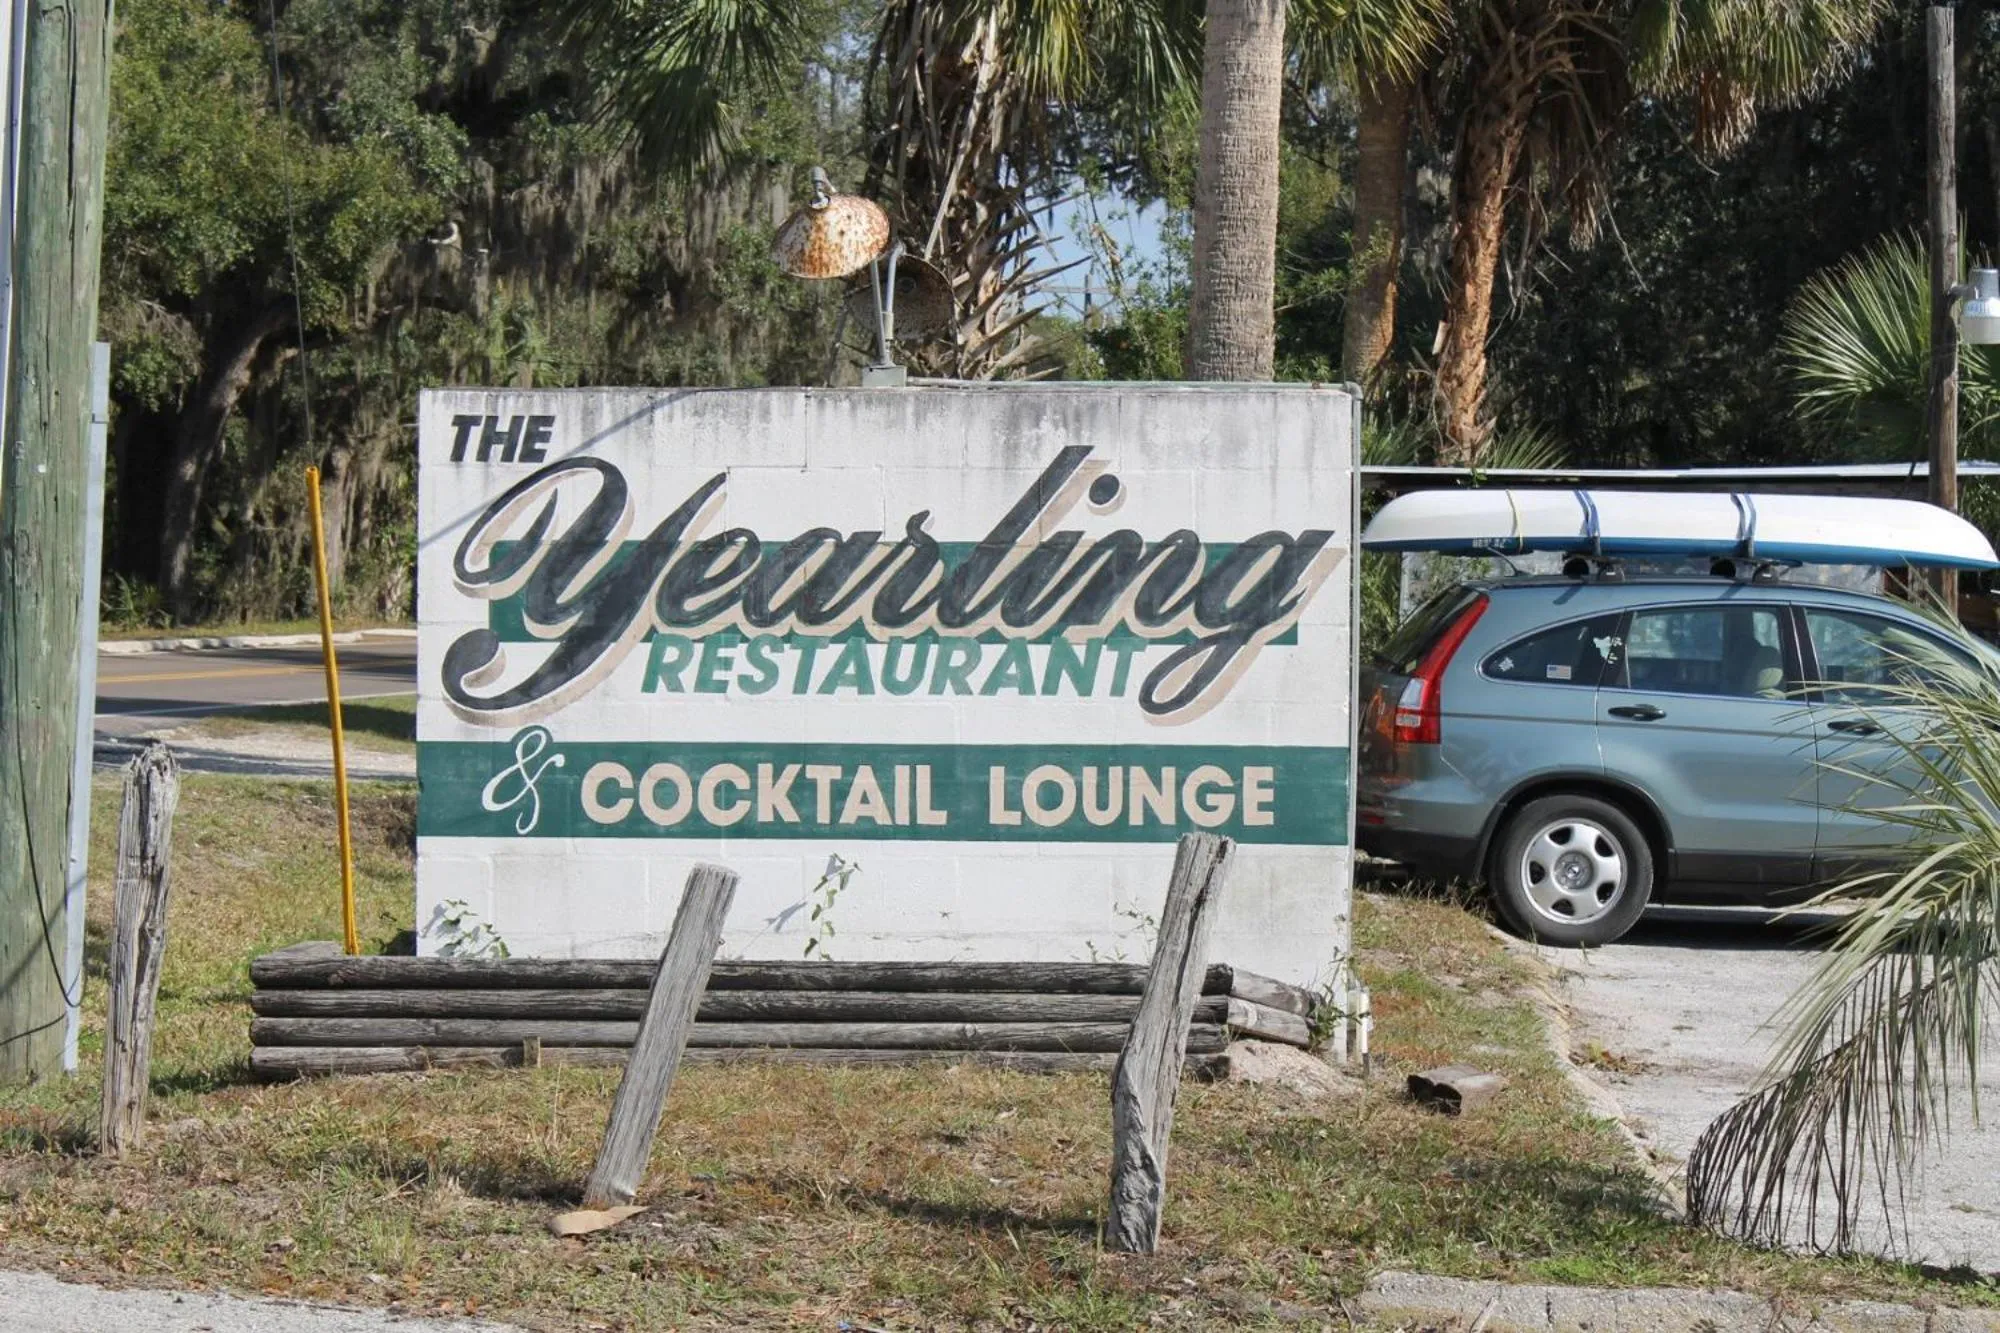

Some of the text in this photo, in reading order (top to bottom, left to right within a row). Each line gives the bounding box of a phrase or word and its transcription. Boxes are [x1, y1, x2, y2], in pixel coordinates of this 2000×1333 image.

[450, 414, 555, 463] THE
[441, 445, 1340, 722] Yearling
[641, 632, 1149, 697] RESTAURANT
[482, 730, 1275, 835] & COCKTAIL LOUNGE
